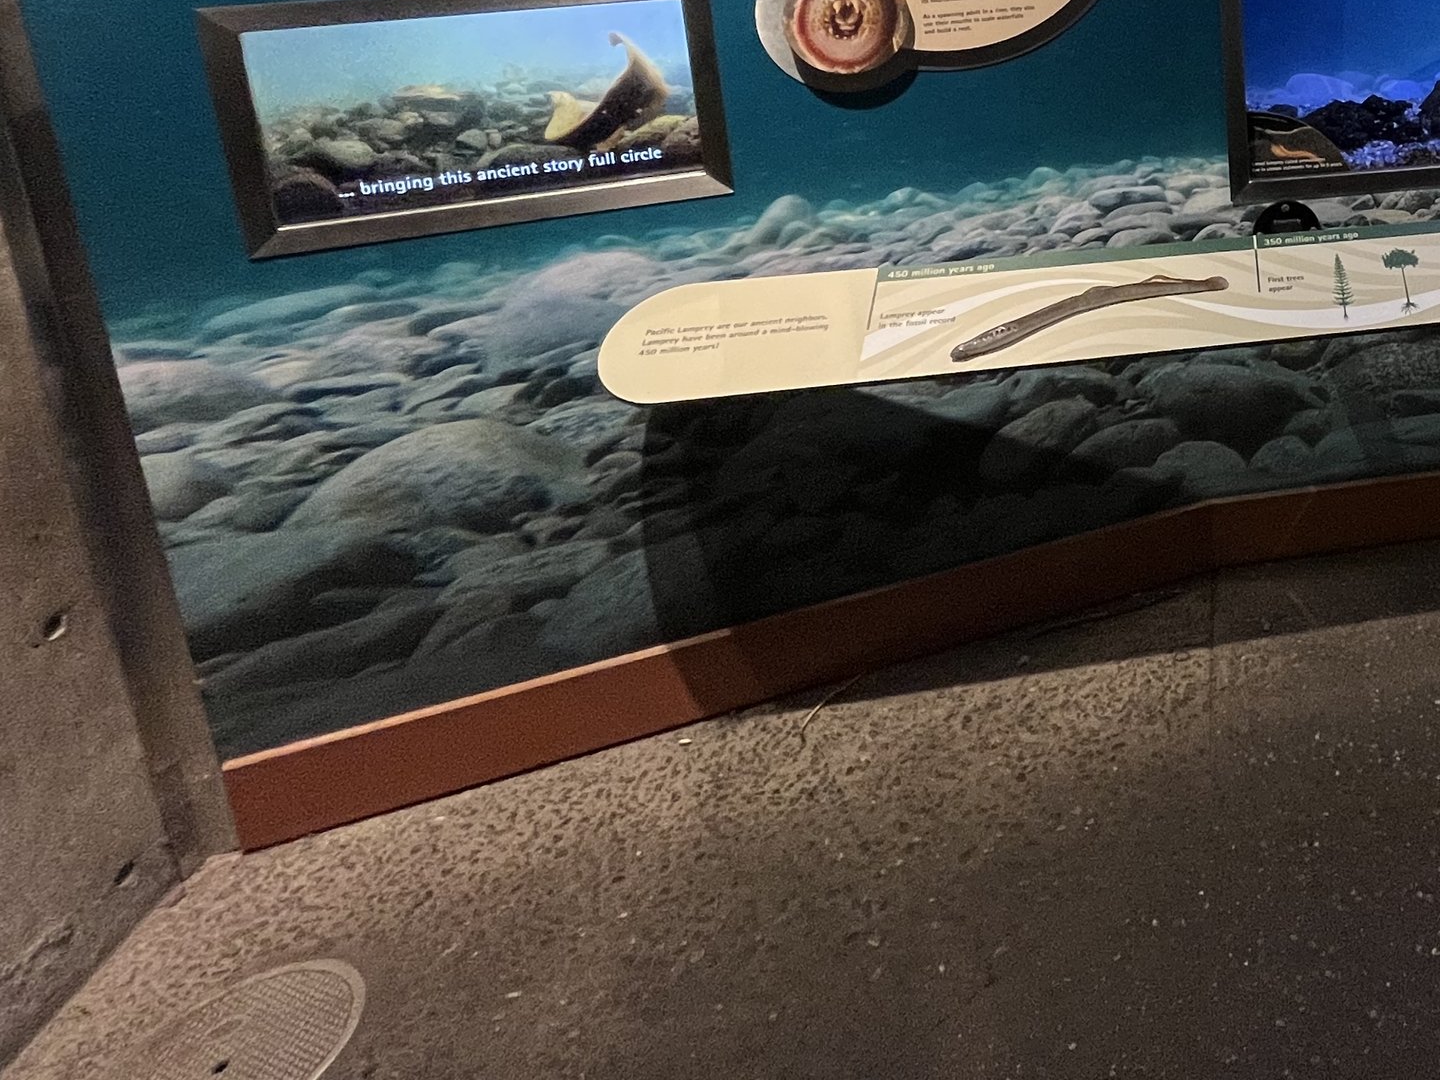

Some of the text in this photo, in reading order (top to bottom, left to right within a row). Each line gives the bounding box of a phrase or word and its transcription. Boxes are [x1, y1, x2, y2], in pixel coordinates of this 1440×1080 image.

[360, 176, 434, 198] bringing
[439, 169, 473, 186] this
[476, 162, 539, 183] ancient
[543, 158, 584, 174] story
[588, 152, 616, 168] full
[620, 146, 664, 163] circle
[1263, 231, 1360, 247] 350 million years ago
[887, 263, 996, 279] 450 million years ago
[1268, 285, 1294, 294] appear
[880, 311, 916, 320] Lamprey
[645, 328, 676, 337] Pacific
[641, 338, 680, 347] Lamprey
[638, 342, 720, 356] 450 million years!
